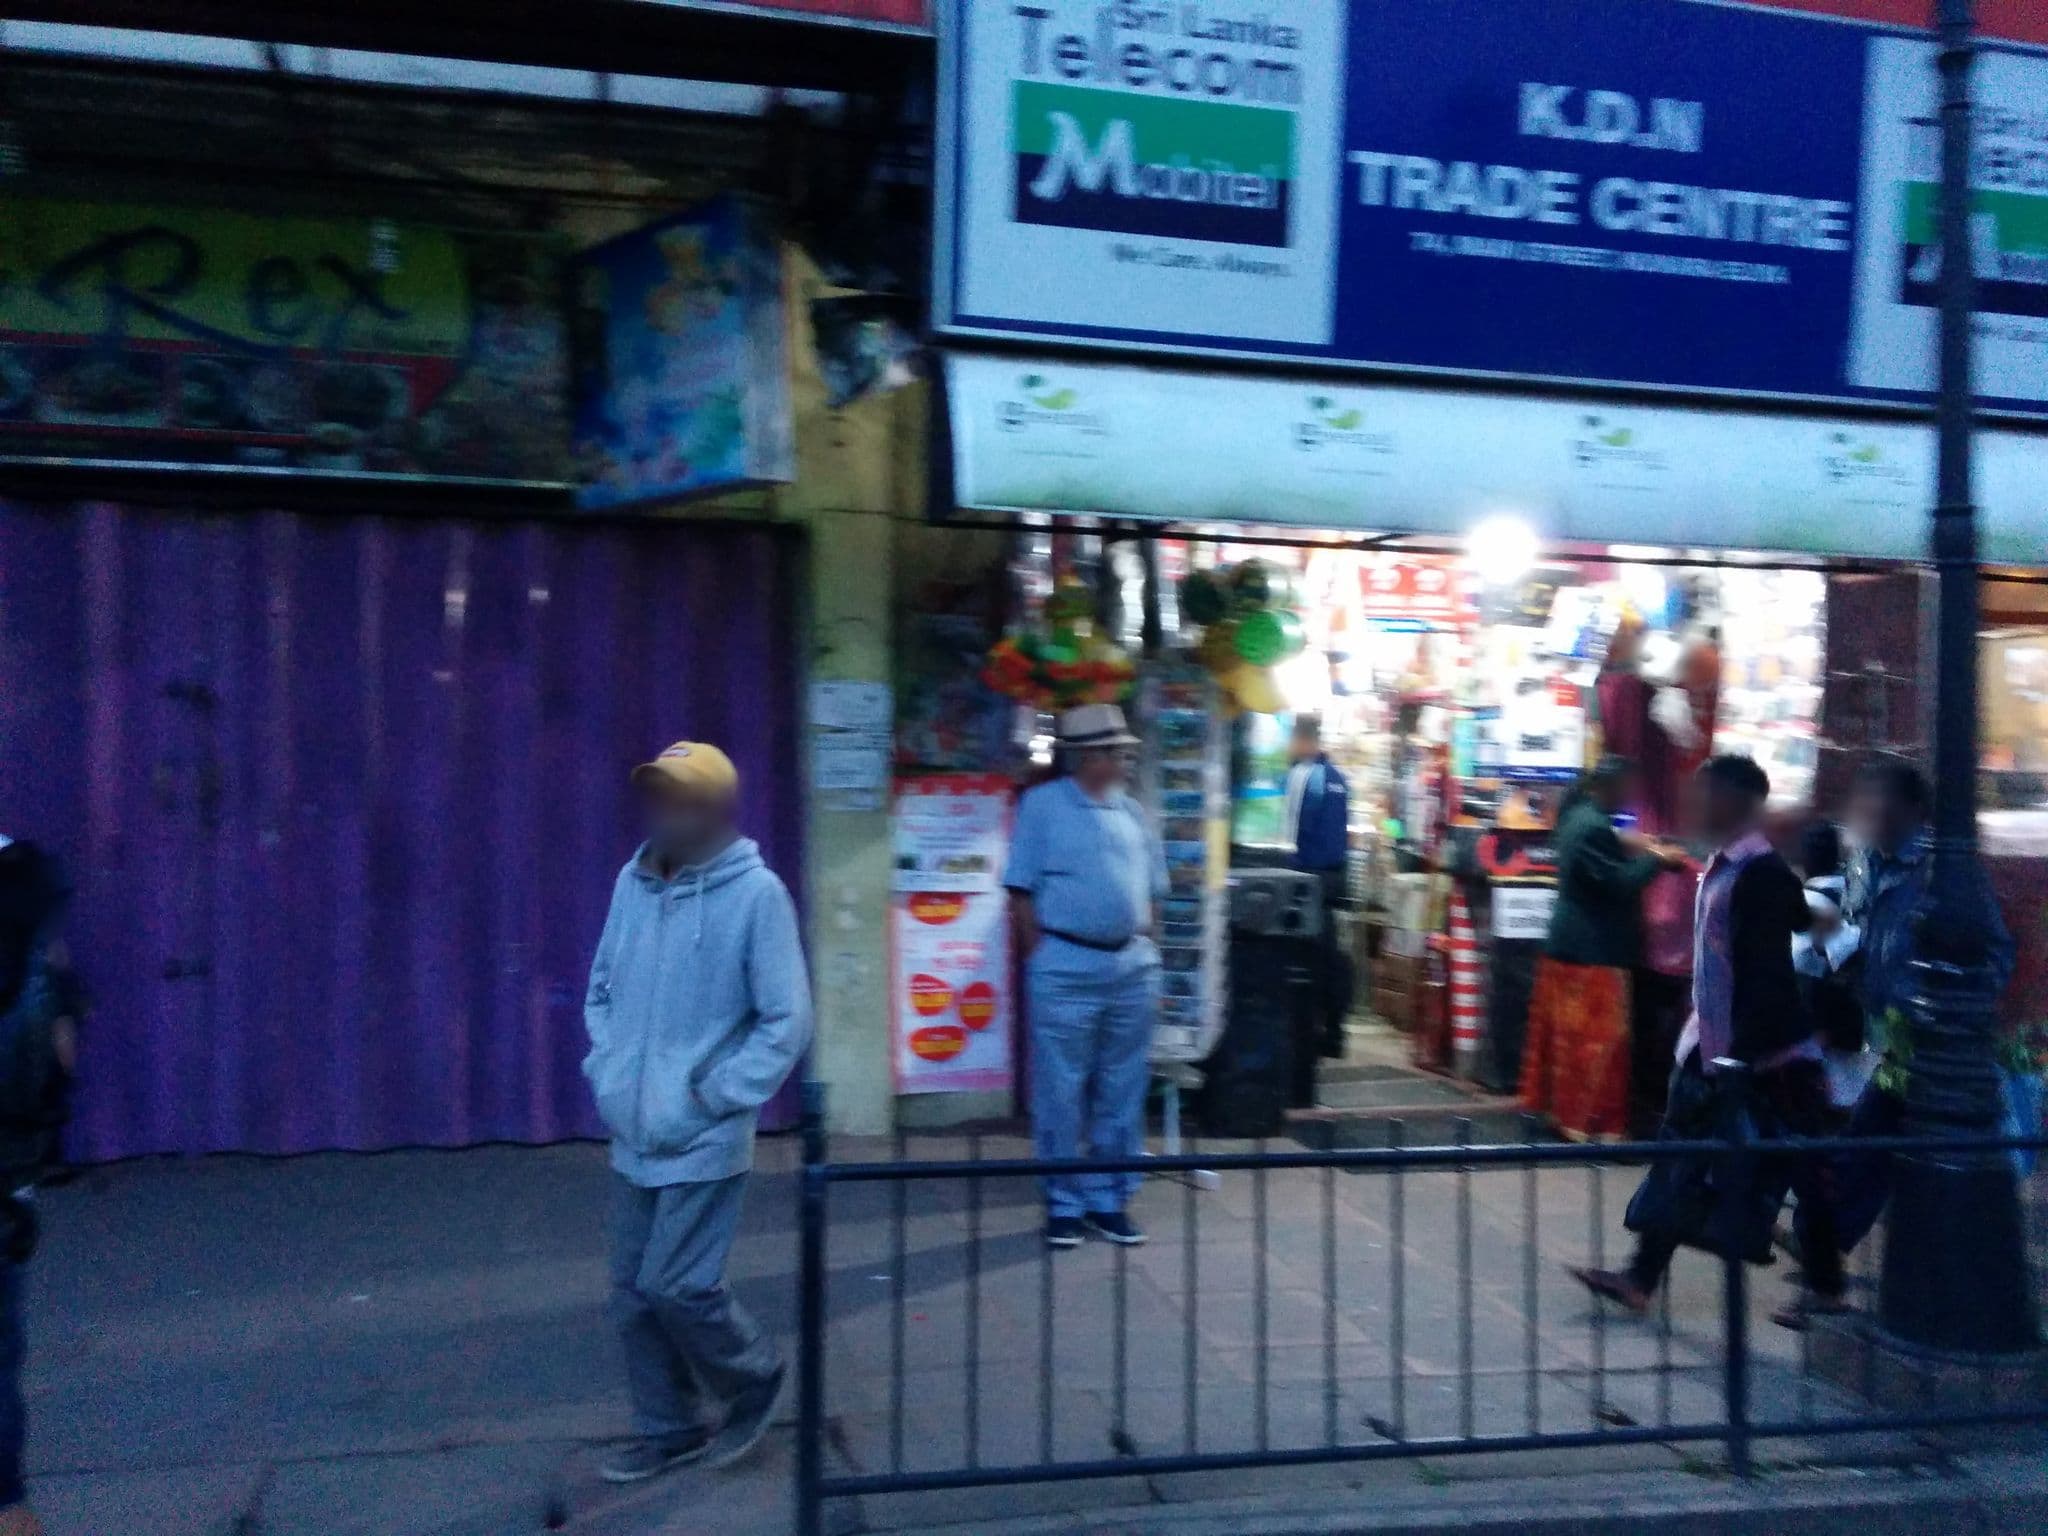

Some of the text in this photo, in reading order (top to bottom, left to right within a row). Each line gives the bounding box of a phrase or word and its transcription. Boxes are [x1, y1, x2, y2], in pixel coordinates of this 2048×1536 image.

[1012, 5, 1299, 103] Telecom
[1346, 149, 1581, 226] TRADE
[1589, 176, 1851, 251] CENTRE
[37, 222, 410, 357] Rex
